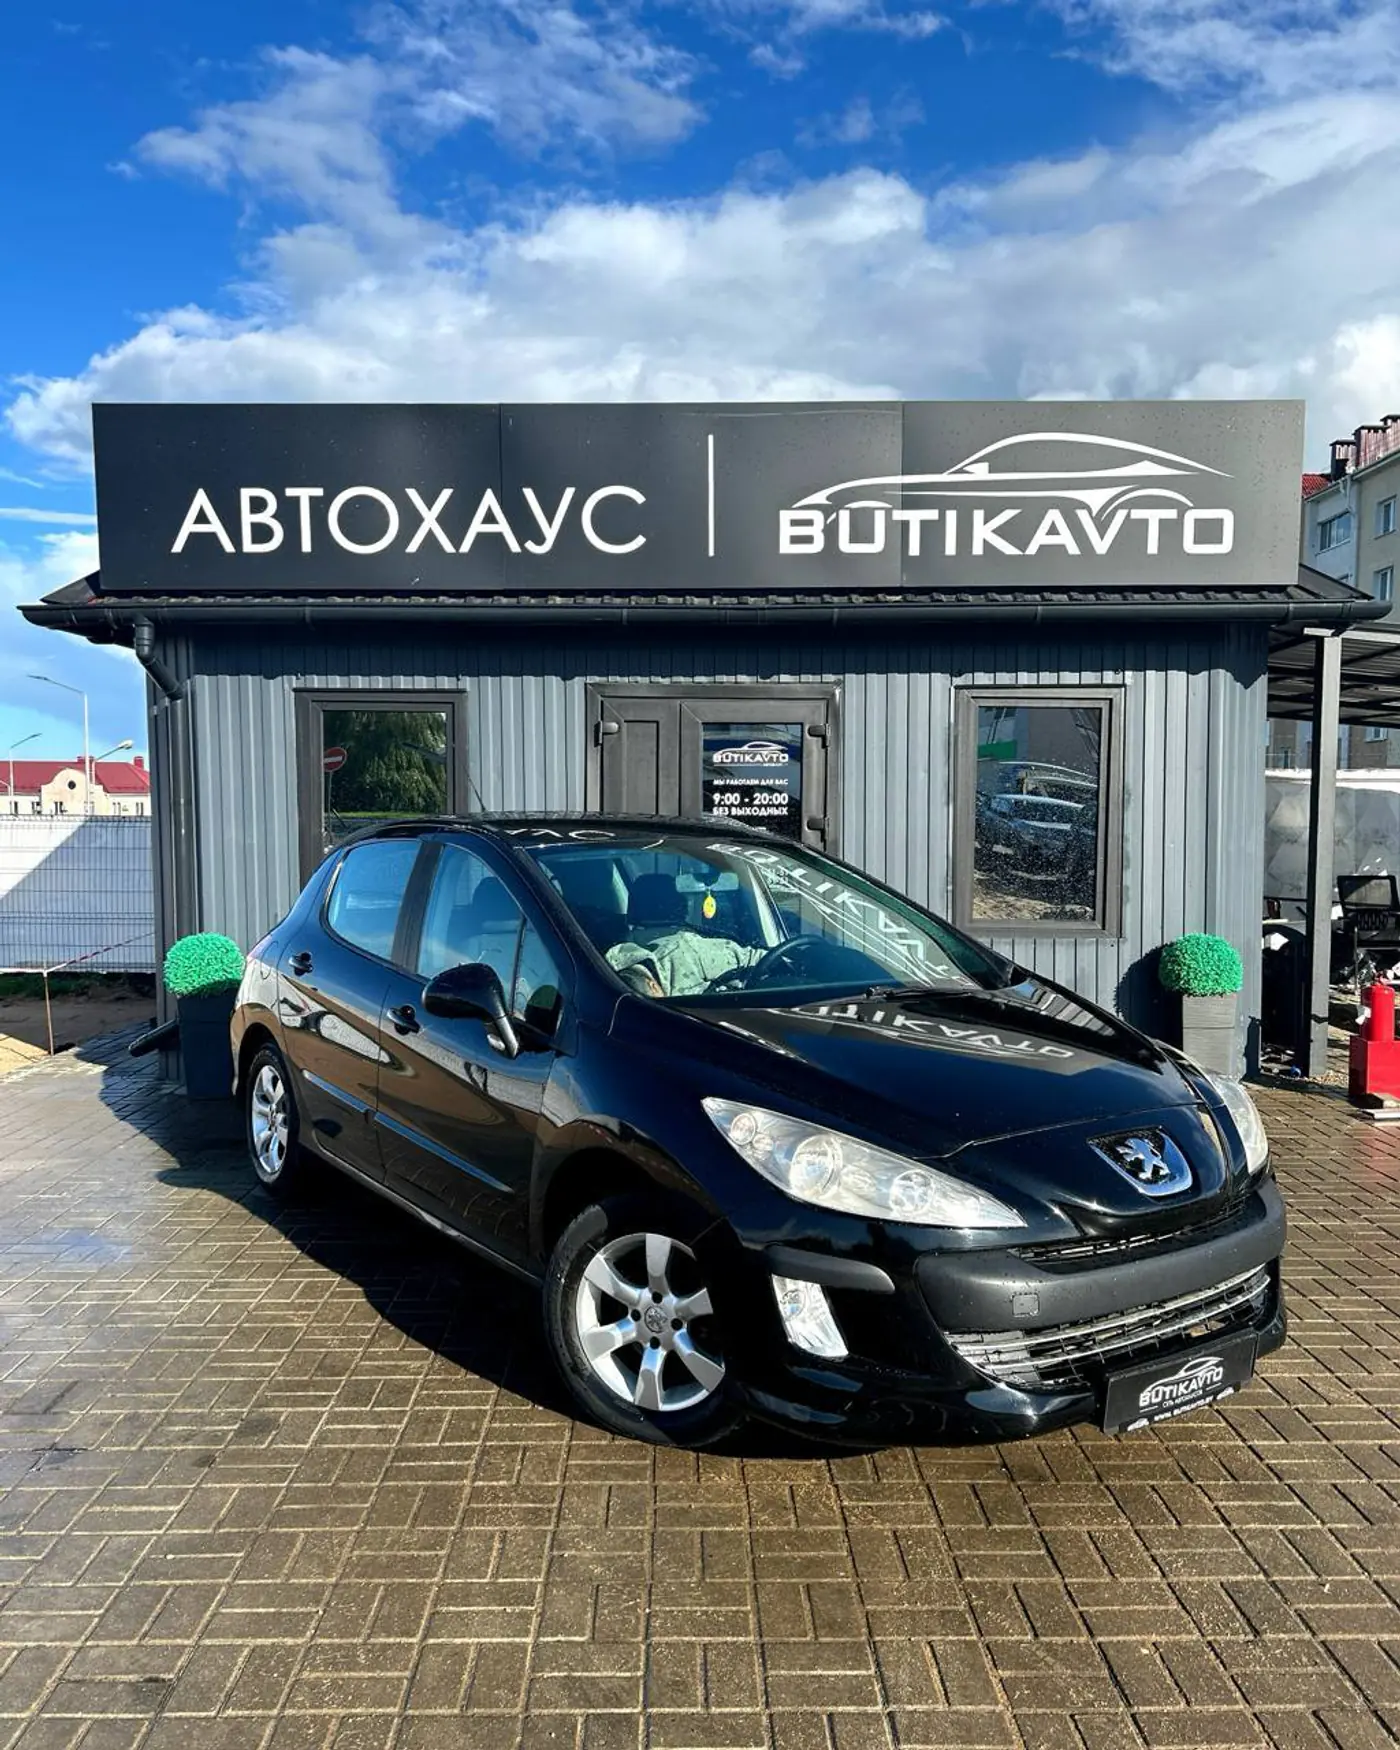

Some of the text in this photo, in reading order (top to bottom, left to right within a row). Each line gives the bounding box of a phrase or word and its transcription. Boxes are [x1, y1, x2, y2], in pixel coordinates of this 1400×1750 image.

[170, 485, 647, 555] АВТОХАУС
[778, 507, 1234, 556] BUTIKAVTO
[712, 753, 789, 763] BUTIKAVTO
[712, 793, 740, 805] 9:00
[753, 793, 789, 805] 20:00
[712, 806, 789, 816] БЕЗ ВЫХОДНЫХ
[1138, 1366, 1224, 1407] BUTIKAVTO
